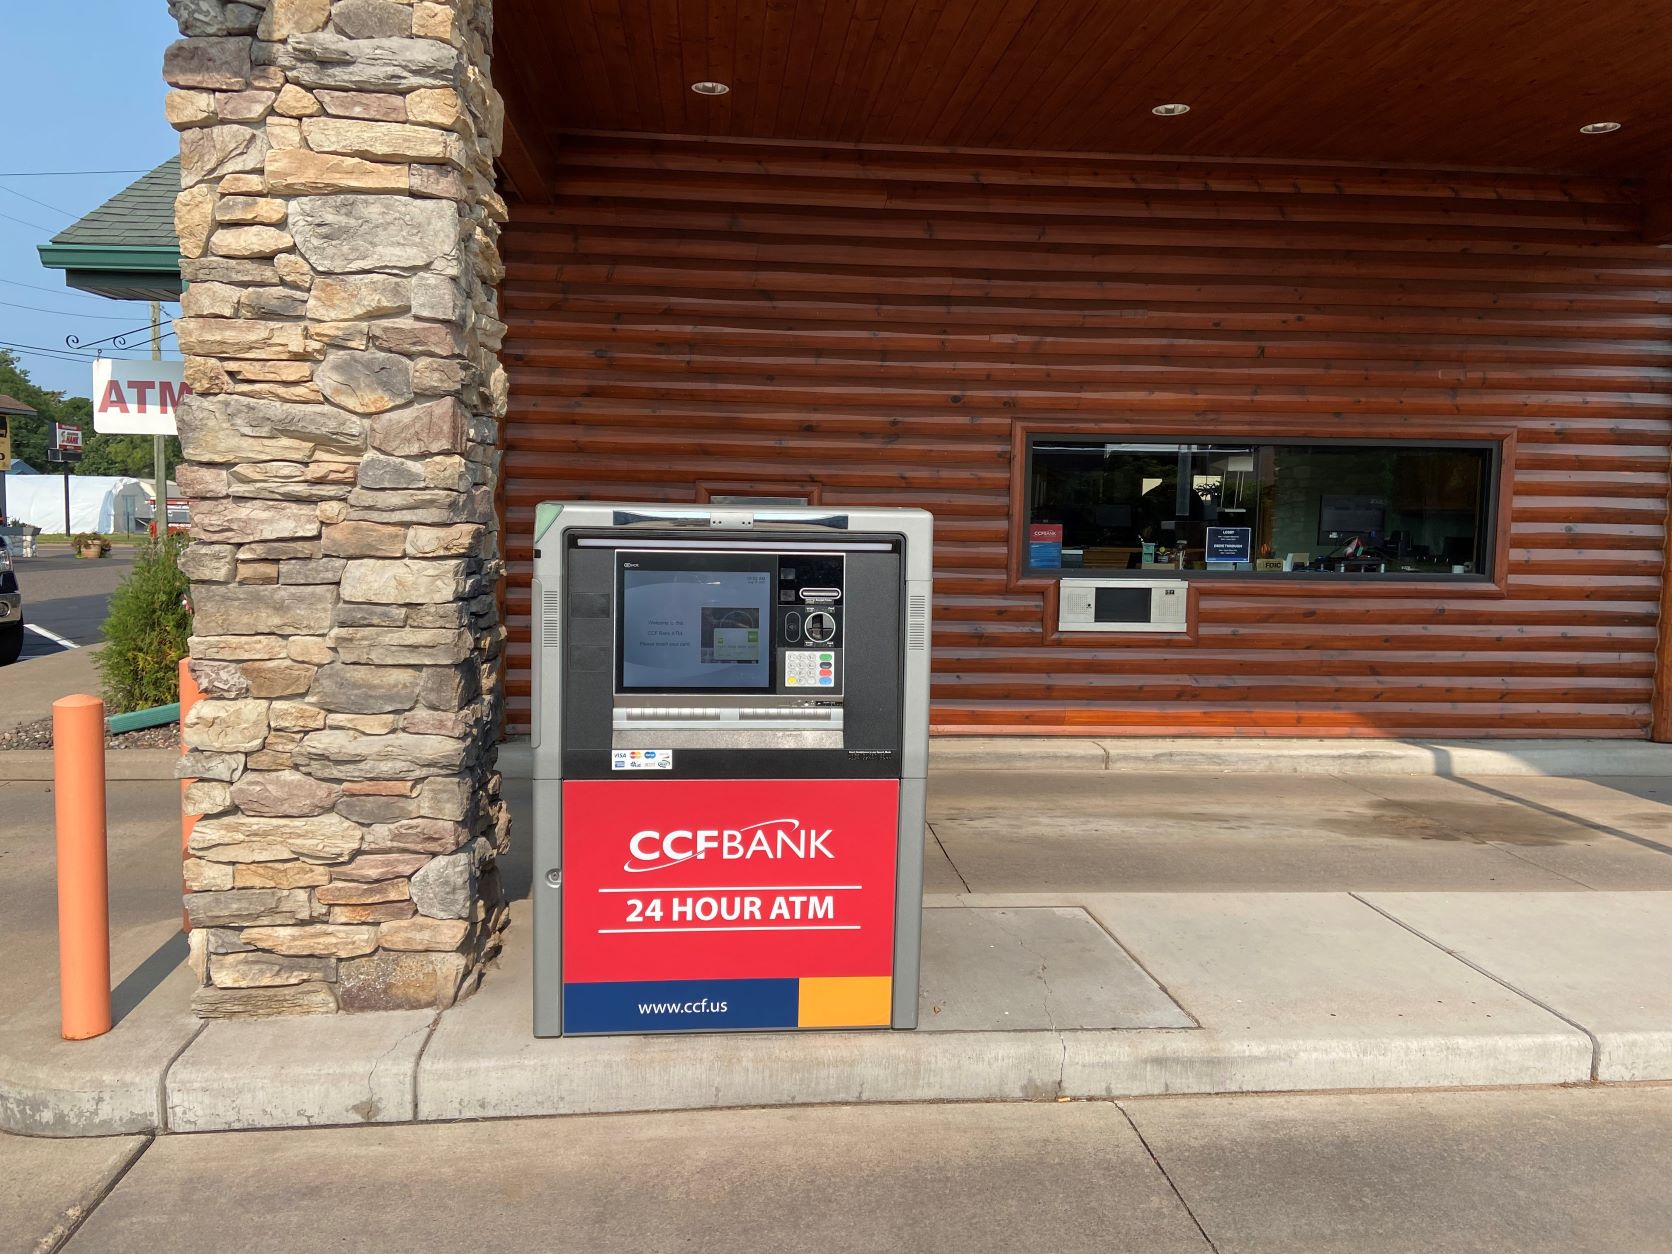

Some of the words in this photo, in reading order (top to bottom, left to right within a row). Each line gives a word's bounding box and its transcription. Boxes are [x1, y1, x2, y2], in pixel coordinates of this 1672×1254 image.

[98, 380, 193, 414] ATM
[627, 827, 836, 862] CCFBANK
[626, 898, 664, 922] 24
[671, 896, 762, 922] HOUR
[770, 896, 834, 920] ATM
[638, 998, 728, 1014] www.ccf.us
